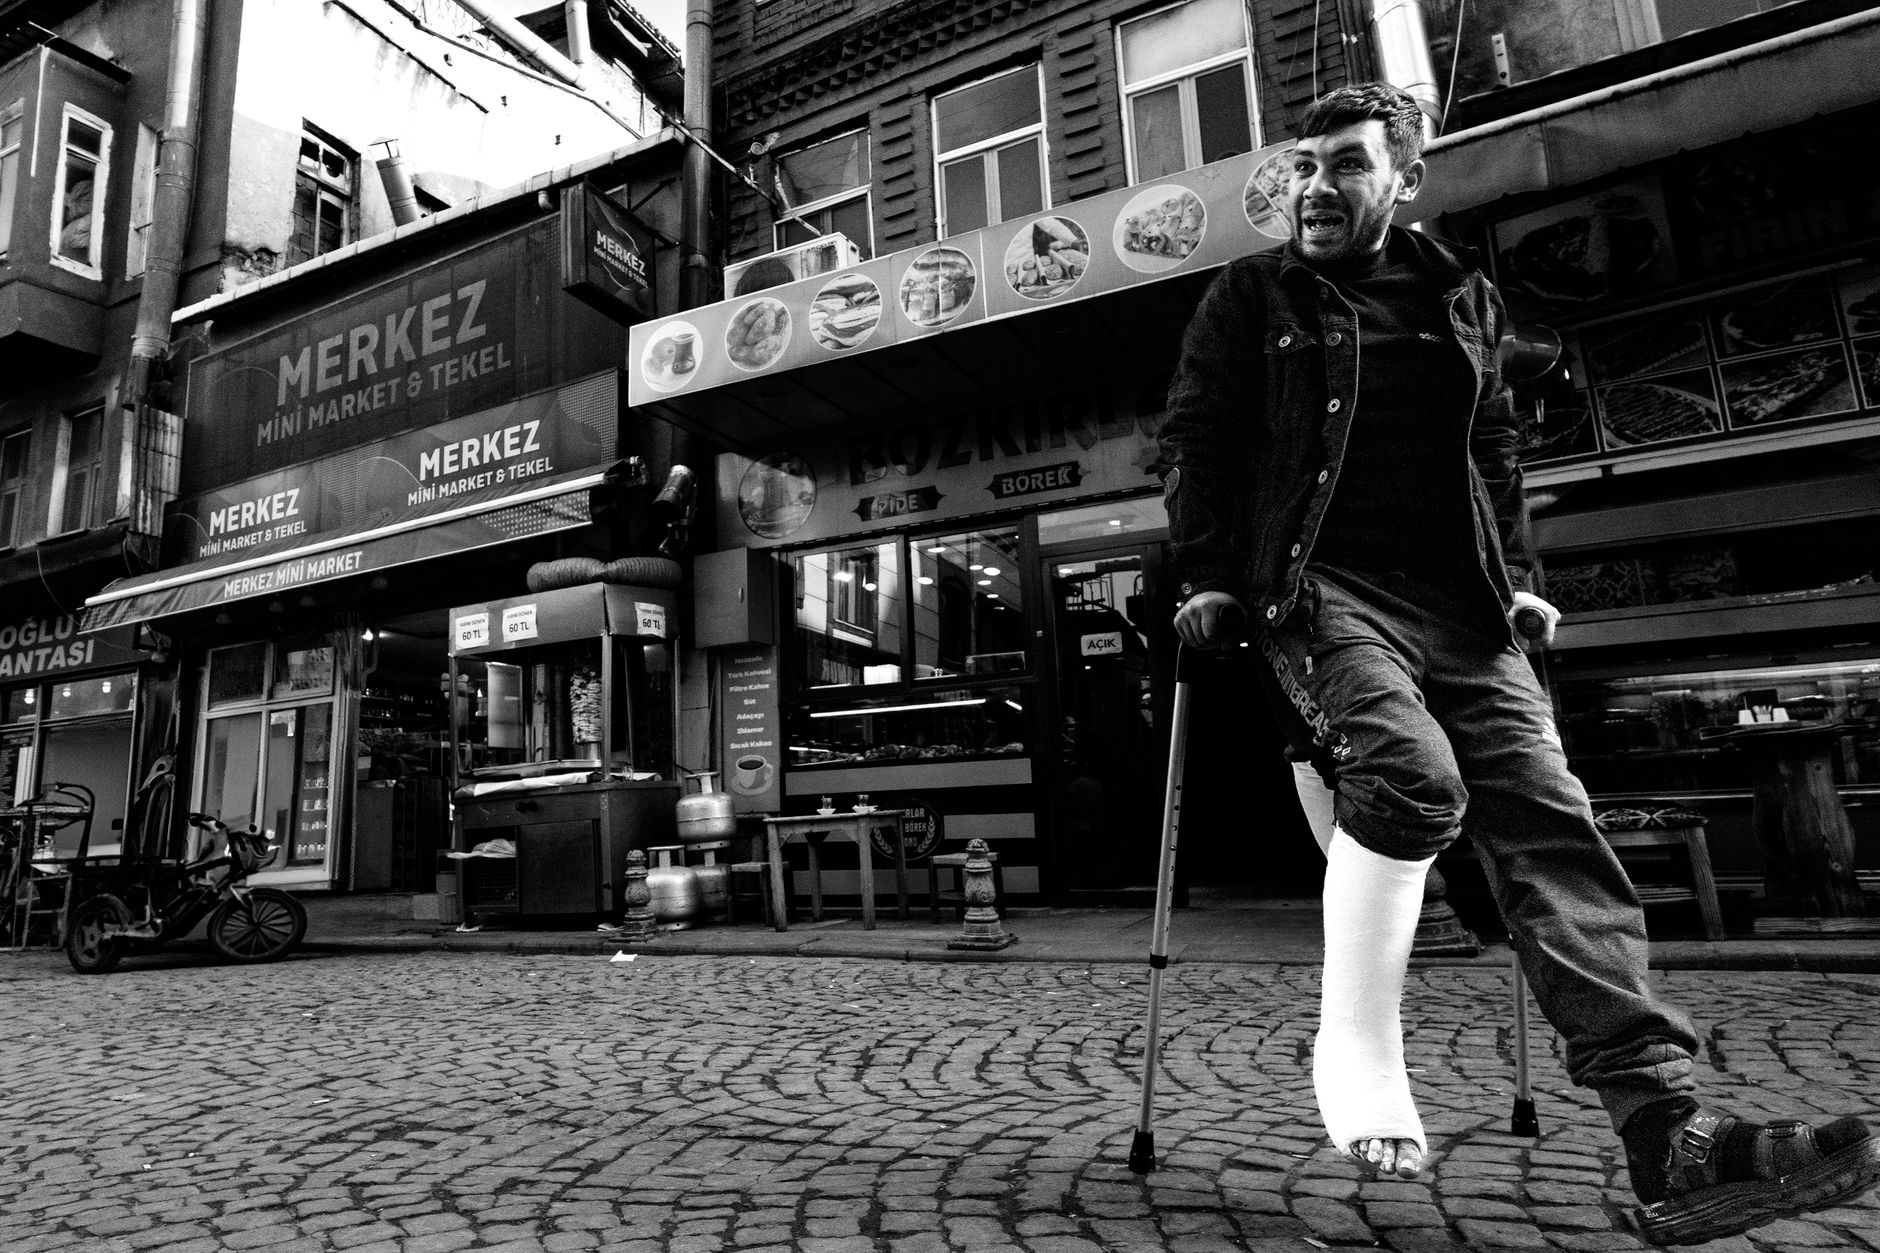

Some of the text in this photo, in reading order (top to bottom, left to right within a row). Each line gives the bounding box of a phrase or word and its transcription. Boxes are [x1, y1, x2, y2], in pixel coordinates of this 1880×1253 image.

[596, 230, 646, 277] MERKEZ
[277, 279, 487, 406] MERKEZ
[257, 343, 512, 447] MİNİ MARKET & TEKEL
[419, 419, 541, 482] MERKEZ
[407, 457, 554, 507] MİNİ MARKET & TEKEL
[1001, 465, 1073, 495] BÖREK
[209, 488, 300, 537] MERKEZ
[199, 520, 308, 558] MİNİ MARKET & TEKEL
[224, 551, 363, 598] MERKEZ MİNİ MARKET
[0, 613, 74, 650] OĞLU
[462, 629, 482, 641] 60 TL
[509, 621, 529, 633] 60 TL
[642, 618, 661, 630] 60 TL
[0, 639, 95, 678] ANTASI
[1087, 638, 1117, 651] AÇIK
[748, 683, 770, 691] Kahve
[749, 740, 772, 748] Kakao
